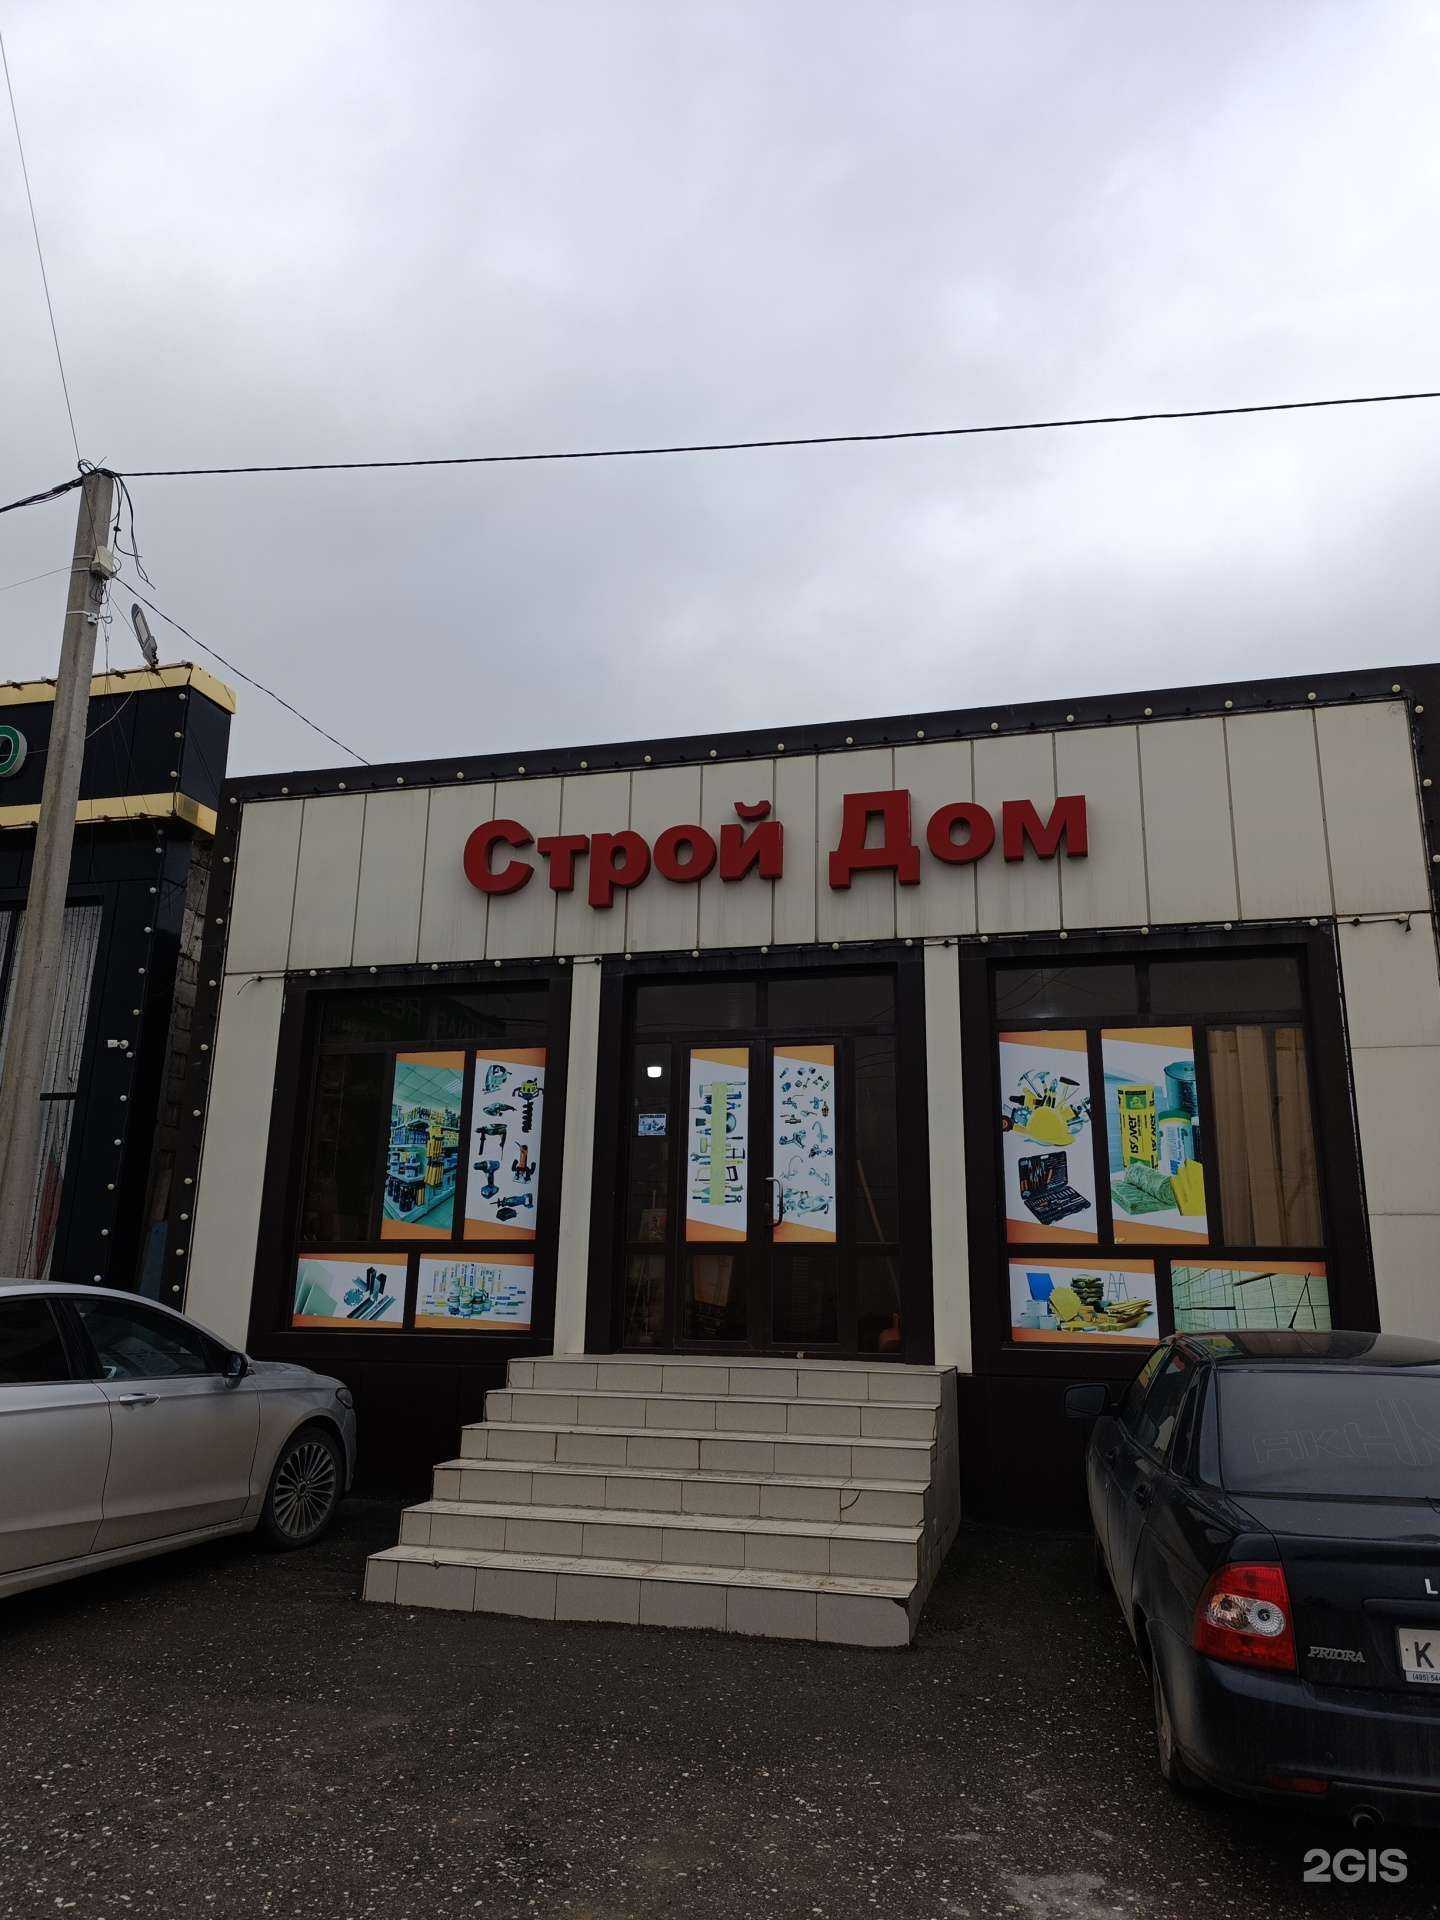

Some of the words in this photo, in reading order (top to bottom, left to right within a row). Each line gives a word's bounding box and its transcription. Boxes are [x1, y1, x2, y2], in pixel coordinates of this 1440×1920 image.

[463, 800, 784, 909] Строй
[829, 789, 1089, 889] Дом
[1307, 1646, 1367, 1664] PRIORA
